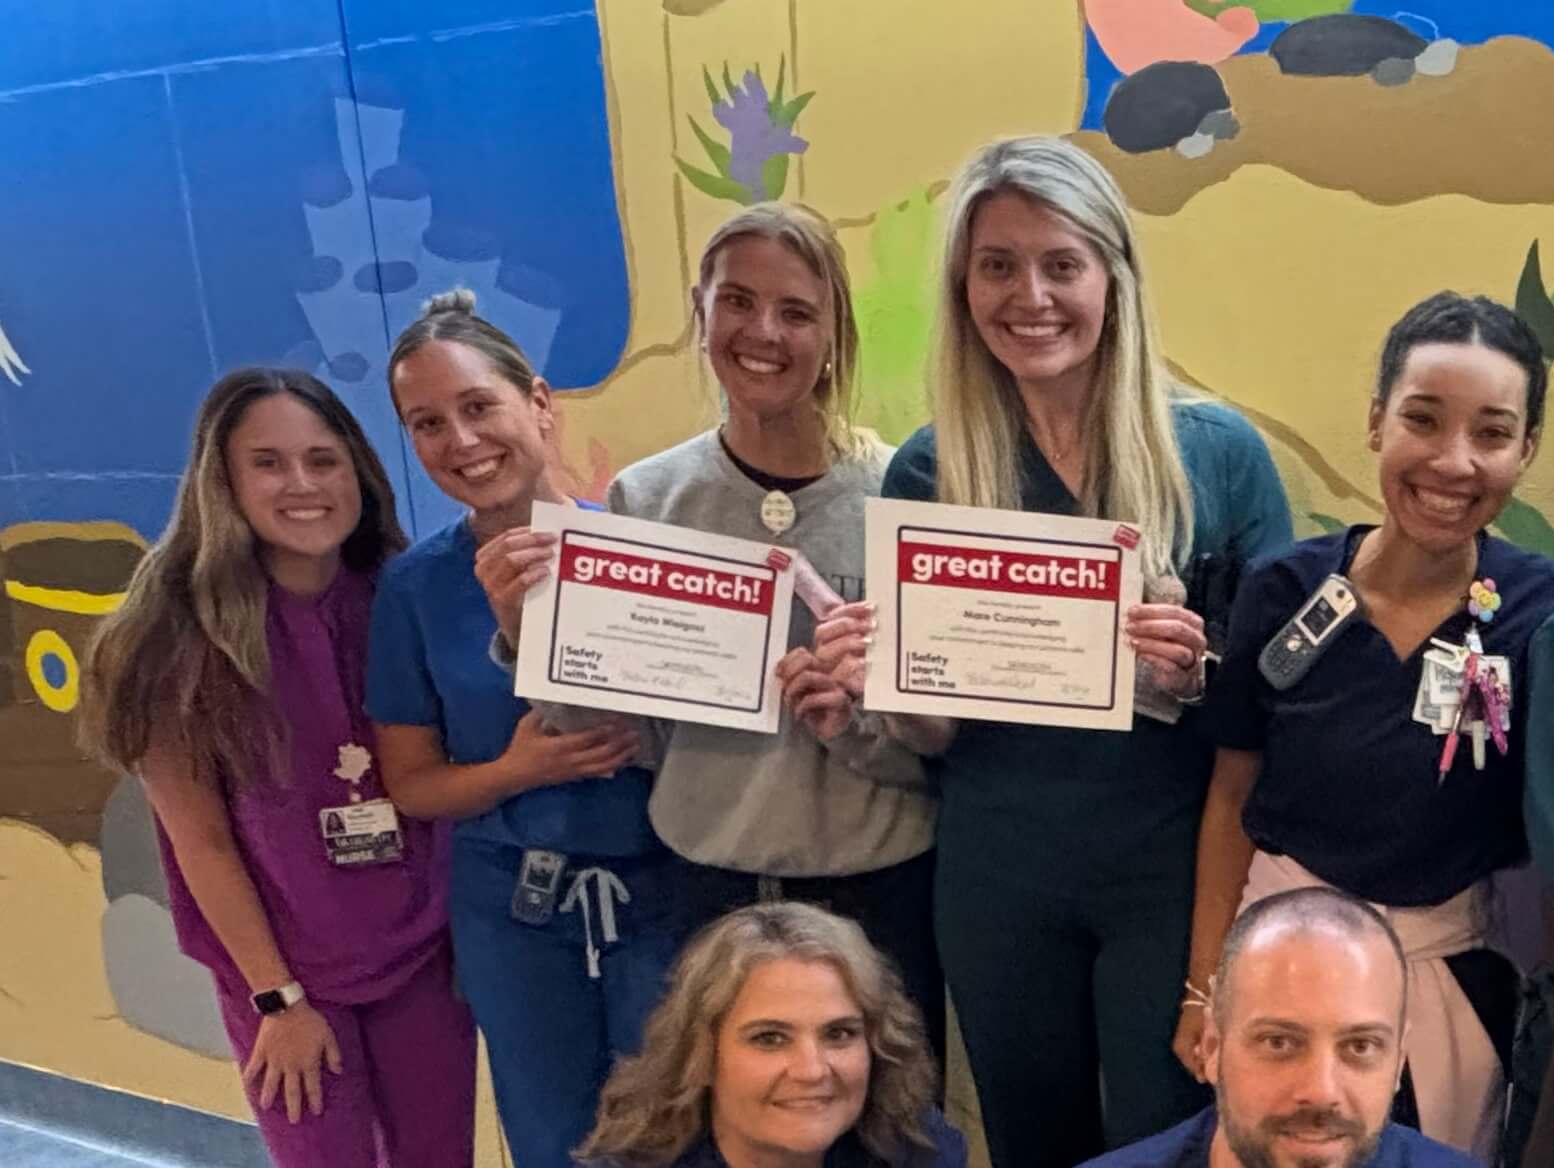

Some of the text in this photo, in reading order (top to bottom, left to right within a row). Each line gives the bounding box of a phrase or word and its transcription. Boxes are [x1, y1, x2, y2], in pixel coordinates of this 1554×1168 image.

[912, 552, 1106, 590] great catch!
[573, 553, 761, 605] great catch!
[566, 645, 603, 661] Safety
[911, 651, 949, 666] Safety
[564, 659, 598, 670] starts
[911, 665, 945, 676] starts
[564, 670, 588, 680] with
[590, 673, 608, 683] me
[911, 678, 956, 689] with me
